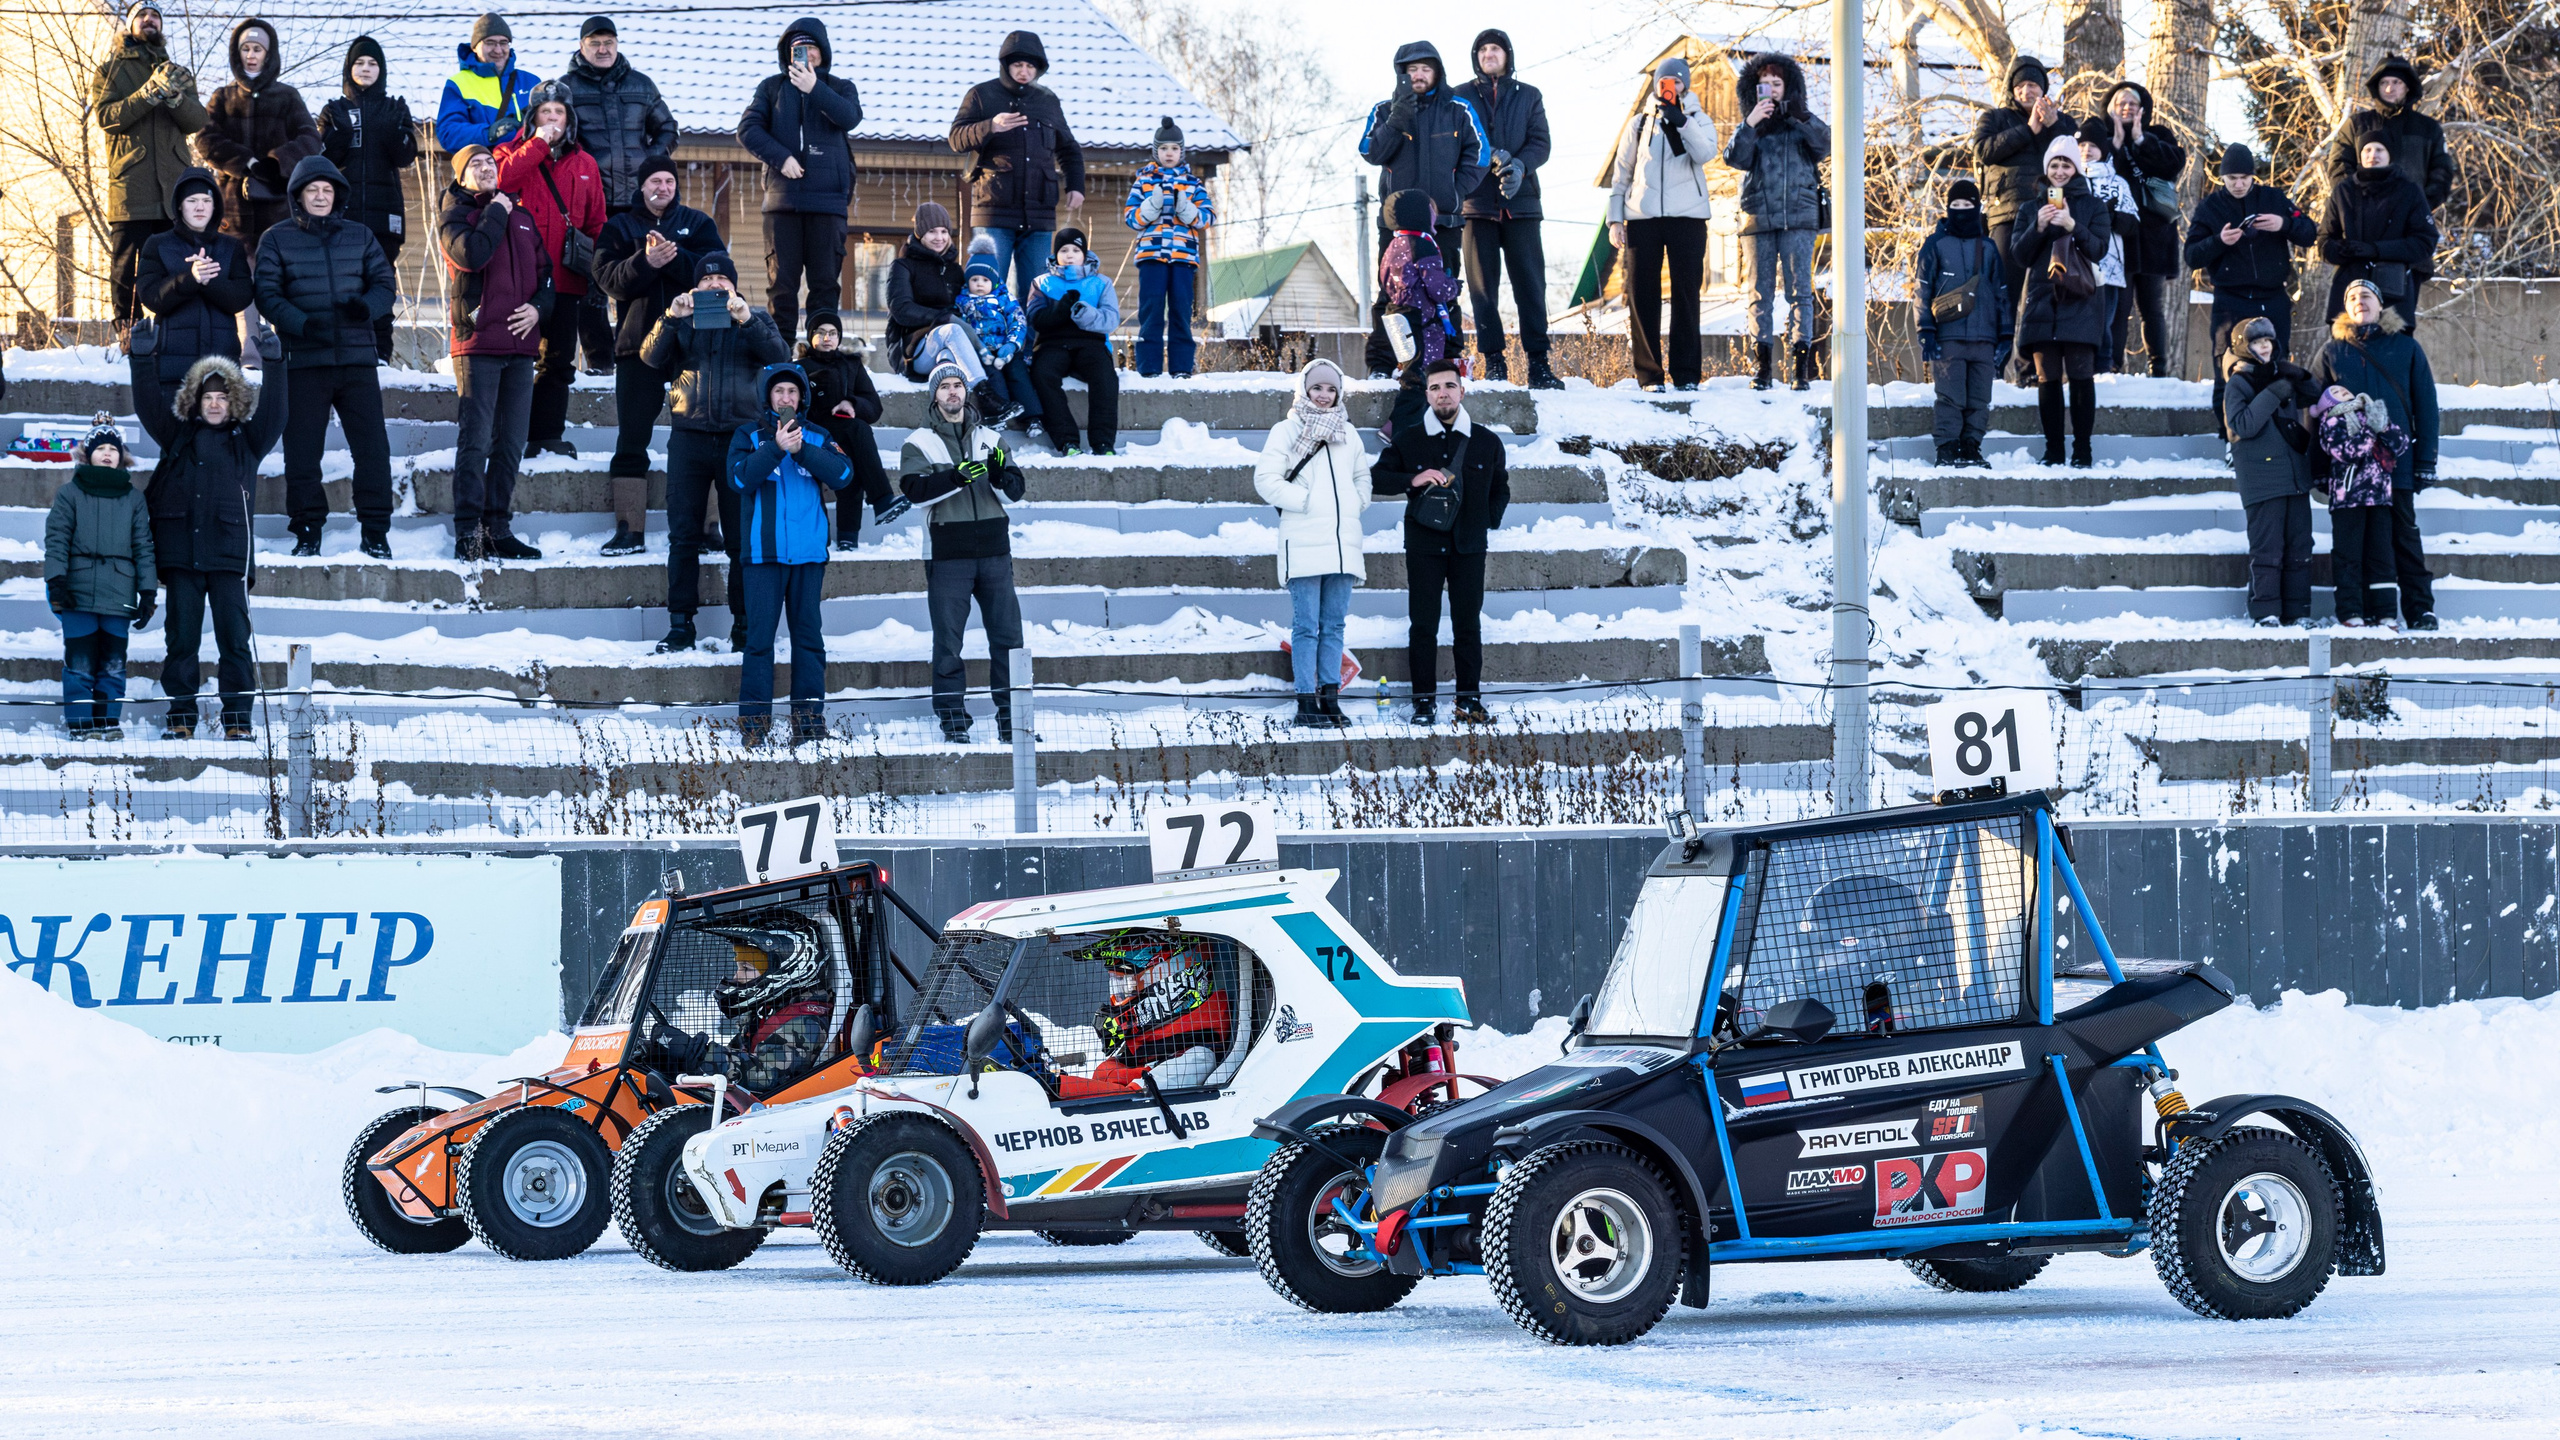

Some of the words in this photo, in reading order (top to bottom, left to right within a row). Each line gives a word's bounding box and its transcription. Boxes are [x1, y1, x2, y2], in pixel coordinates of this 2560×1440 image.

[1954, 708, 2021, 776] 81
[741, 802, 821, 873] 77
[1166, 810, 1261, 870] 72
[1316, 945, 1361, 982] 72
[573, 1035, 624, 1053] НОВОСИБИРСК
[1799, 1061, 1900, 1090] ГРИГОРЬЕВ
[1907, 1047, 2012, 1076] АЛЕКСАНДР
[1929, 1099, 1949, 1112] ЕДУ
[1950, 1099, 1960, 1108] НА
[1946, 1106, 1978, 1116] ТОПЛИВЕ
[994, 1126, 1084, 1152] ЧЕРНОВ
[1808, 1127, 1909, 1149] RAVENOL
[1930, 1132, 1975, 1141] MOTORSPORT
[732, 1142, 750, 1156] РГ
[757, 1141, 800, 1153] Медиа
[1874, 1211, 1944, 1226] РАЛЛИ-КРОСС
[1946, 1206, 1984, 1219] РОССИИ
